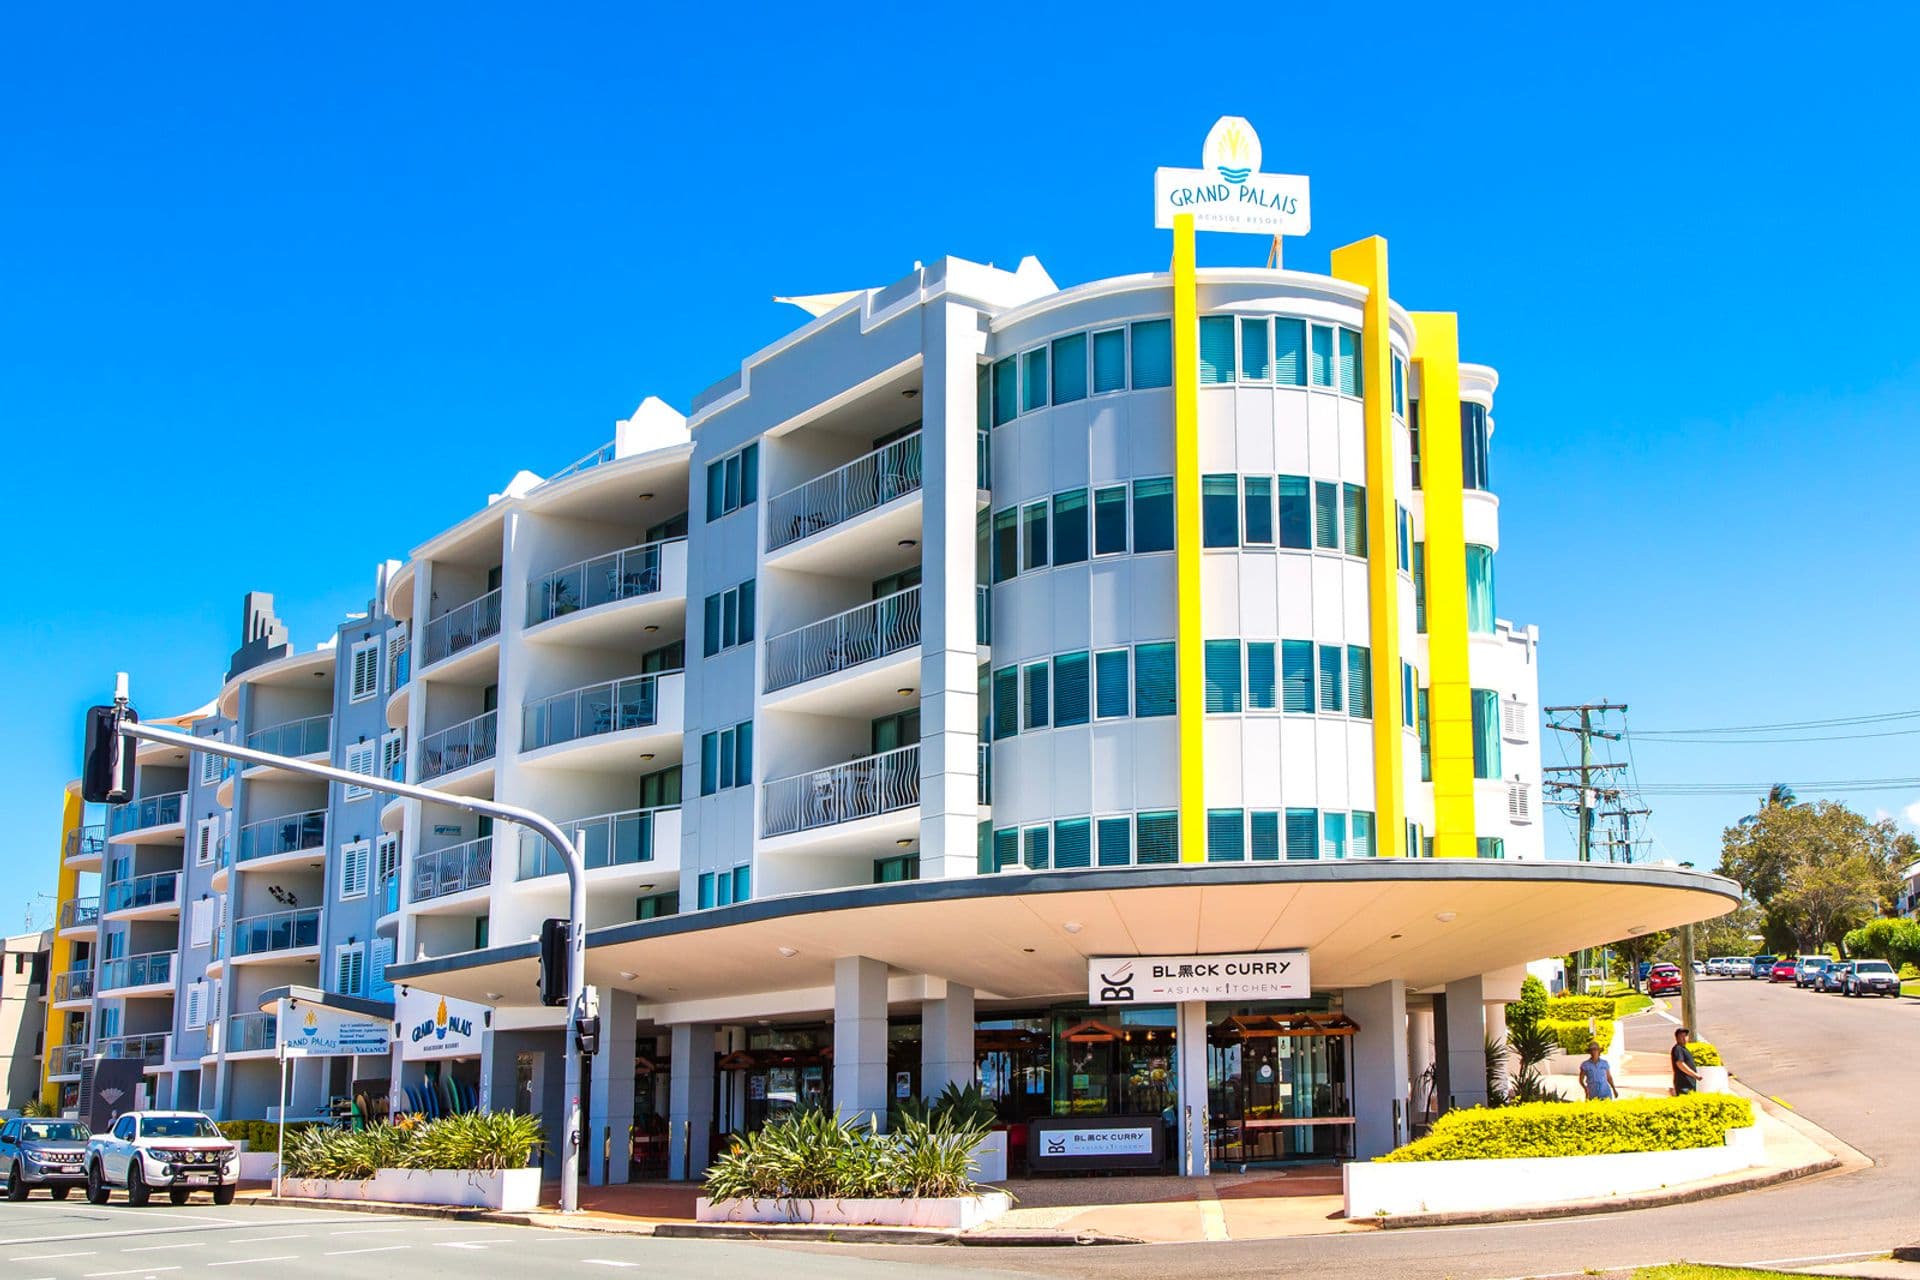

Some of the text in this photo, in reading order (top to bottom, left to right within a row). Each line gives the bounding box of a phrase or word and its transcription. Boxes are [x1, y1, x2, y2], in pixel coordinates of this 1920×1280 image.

[1170, 184, 1299, 215] GRAND PALAIS
[1225, 961, 1291, 976] CURRY
[1167, 985, 1209, 995] ASIAN
[1110, 1133, 1144, 1141] CURRY
